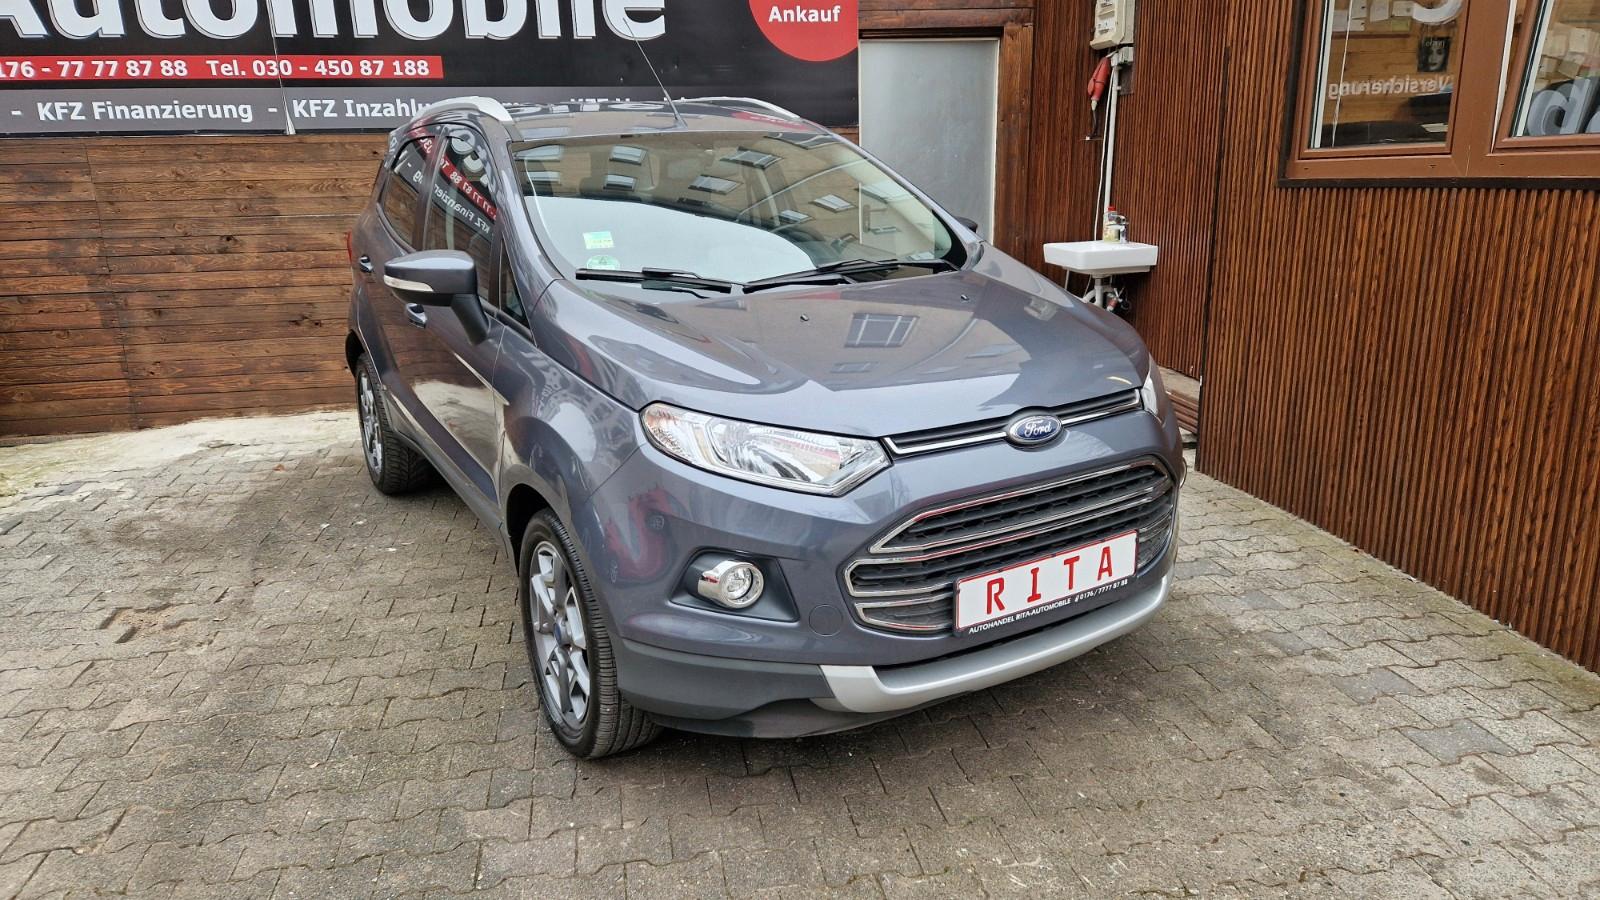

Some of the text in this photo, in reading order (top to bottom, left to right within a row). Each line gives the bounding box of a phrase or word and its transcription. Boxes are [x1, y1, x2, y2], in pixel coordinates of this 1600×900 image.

[768, 5, 842, 23] Ankauf
[57, 61, 84, 77] 77
[91, 61, 118, 77] 77
[125, 60, 152, 77] 87
[160, 60, 188, 77] 88
[206, 60, 246, 76] Tel.
[252, 60, 292, 76] 030
[314, 60, 353, 75] 450
[359, 60, 384, 75] 87
[392, 60, 430, 75] 188
[37, 102, 86, 121] KFZ
[93, 101, 253, 122] Finanzierung
[292, 100, 337, 118] KFZ
[1024, 420, 1052, 437] Ford
[969, 616, 1015, 634] AUTOHANDEL
